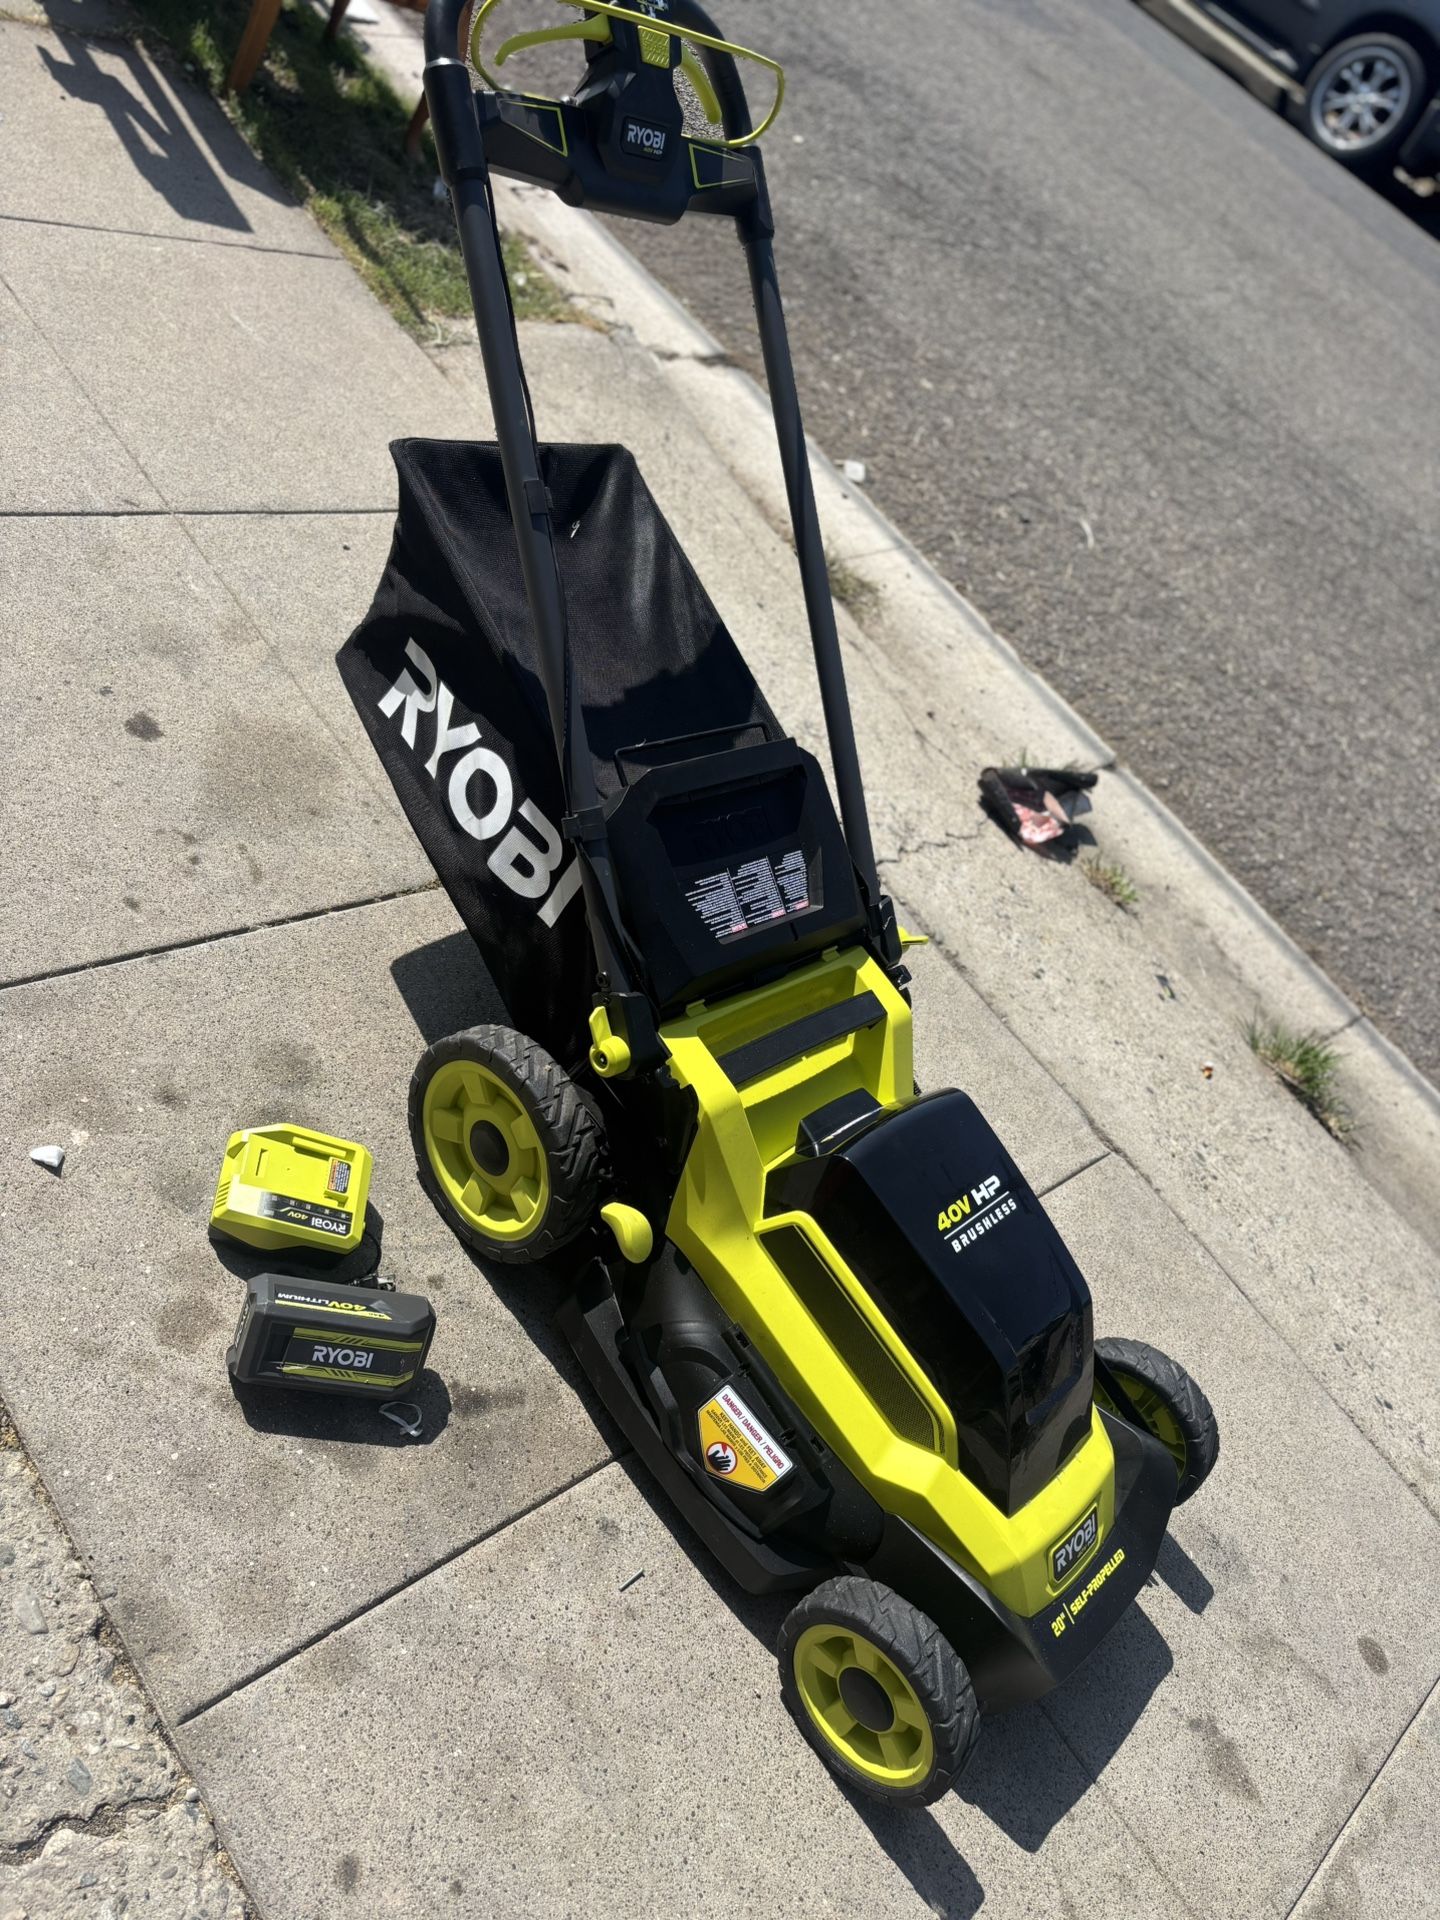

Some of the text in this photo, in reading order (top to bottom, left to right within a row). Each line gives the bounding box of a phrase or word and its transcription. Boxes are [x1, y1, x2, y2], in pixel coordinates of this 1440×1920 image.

[627, 124, 666, 150] RYOBI
[377, 636, 583, 929] RYOBI
[287, 1211, 346, 1234] RYOBI 40V
[937, 1175, 1001, 1231] 40V HP
[951, 1198, 1017, 1253] BRUSHLESS
[312, 1345, 375, 1369] RYOBI
[722, 1393, 743, 1418] DANGER
[742, 1419, 763, 1444] DANGER
[763, 1444, 785, 1469] PELIGRO
[1055, 1513, 1096, 1573] RYOBI
[1051, 1612, 1066, 1638] 20"
[1069, 1548, 1126, 1616] SELF-PROPELLED
